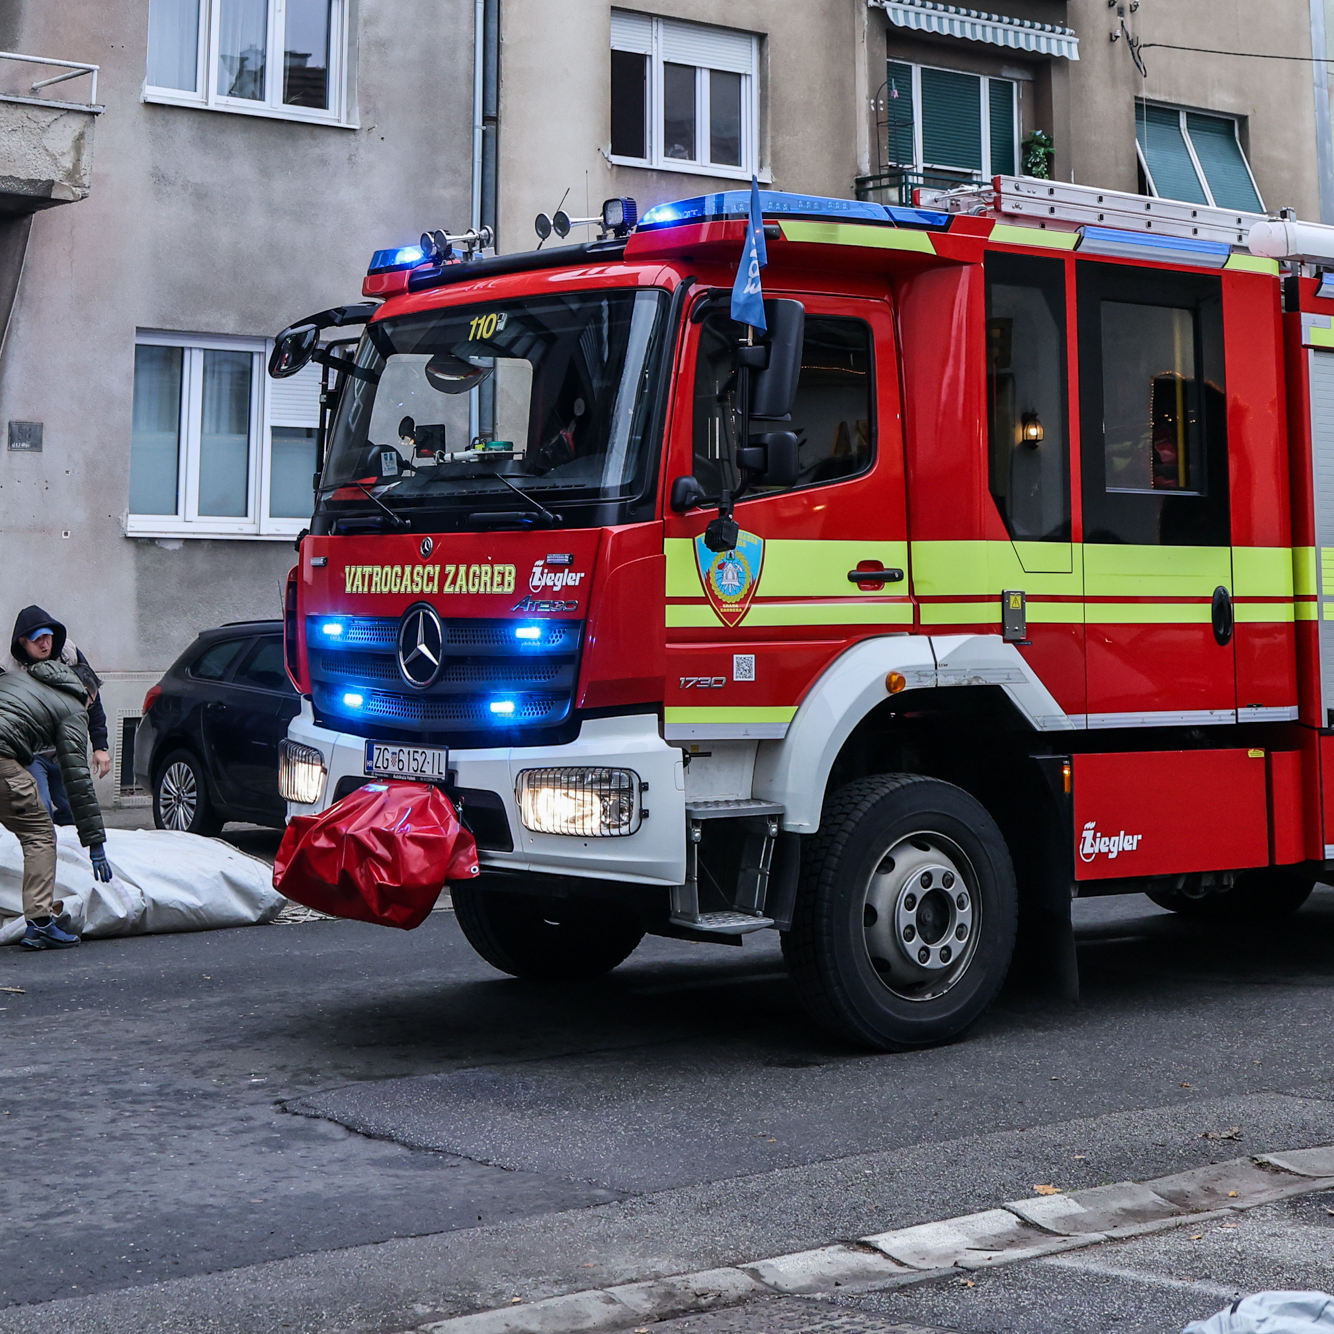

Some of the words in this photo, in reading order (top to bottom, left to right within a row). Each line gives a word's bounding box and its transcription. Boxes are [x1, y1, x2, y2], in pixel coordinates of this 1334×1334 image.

[468, 313, 497, 341] 110
[344, 564, 441, 594] VATROGASCI
[442, 564, 516, 594] ZAGREB
[529, 563, 585, 593] Ziegler
[679, 677, 727, 689] 1730
[374, 747, 390, 769] ZG
[1079, 822, 1143, 863] Ziegler
